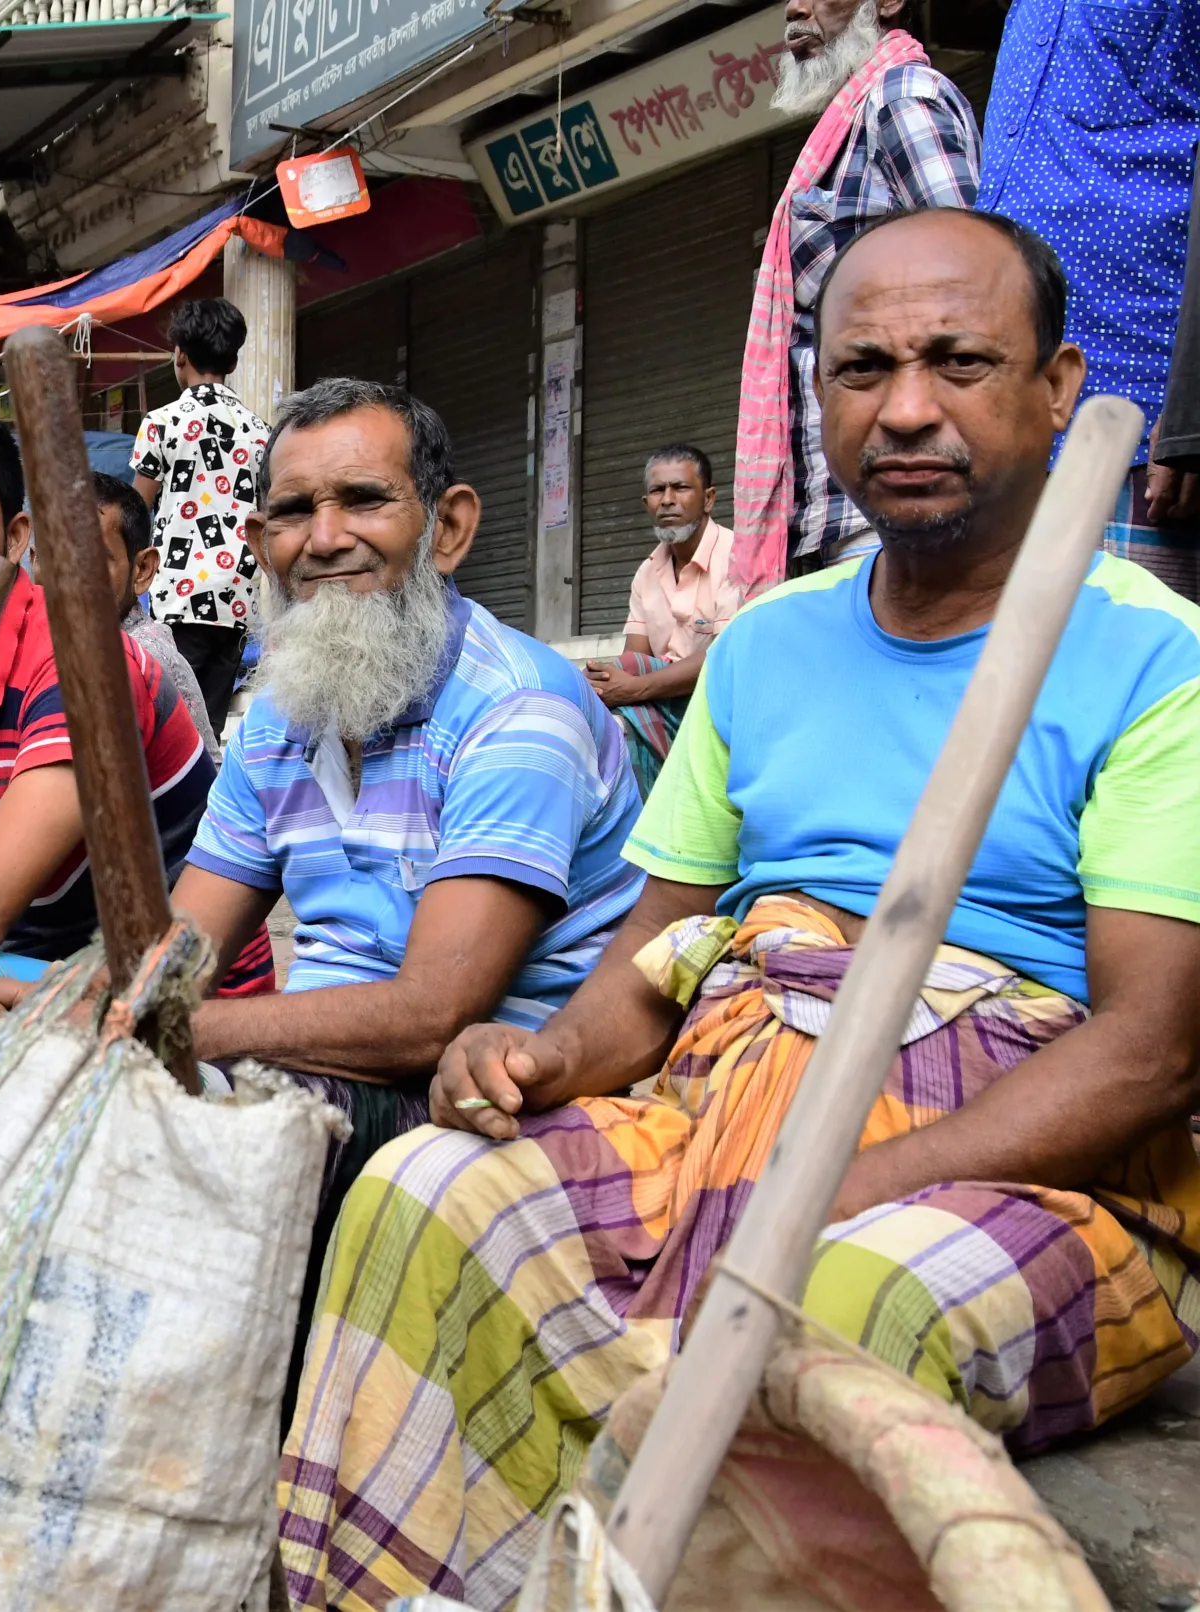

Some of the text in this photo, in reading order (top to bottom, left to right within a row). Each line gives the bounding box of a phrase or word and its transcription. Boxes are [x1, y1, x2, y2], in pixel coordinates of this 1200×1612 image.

[344, 55, 358, 76] এর
[503, 112, 609, 194] একুশে
[608, 84, 705, 156] পেপার
[709, 42, 786, 118] ষ্টেশ
